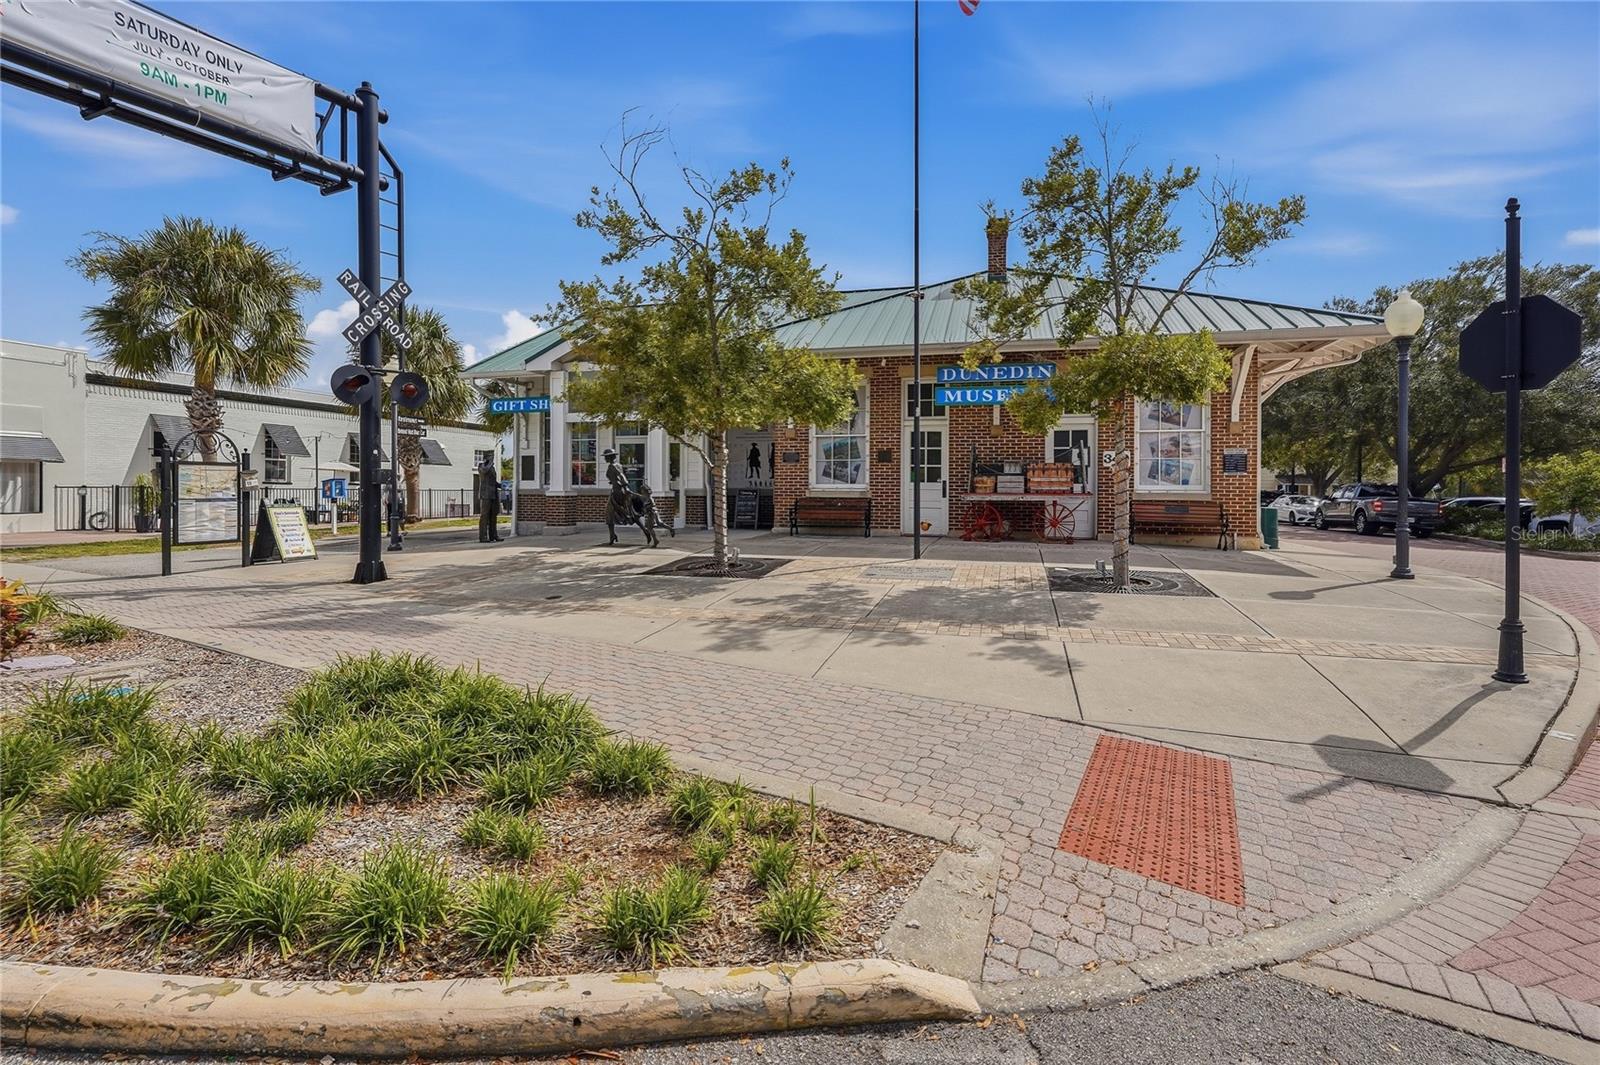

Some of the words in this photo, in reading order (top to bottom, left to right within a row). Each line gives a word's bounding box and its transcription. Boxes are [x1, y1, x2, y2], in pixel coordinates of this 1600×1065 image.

[114, 10, 200, 58] SATURDAY
[205, 50, 243, 74] ONLY
[133, 41, 164, 59] JULY
[175, 57, 230, 86] OCTOBER
[140, 61, 178, 88] 9AM
[195, 83, 228, 105] 1PM
[347, 282, 408, 342] CROSSING
[943, 365, 1053, 381] DUNEDIN
[944, 387, 1050, 402] MUSE
[493, 400, 527, 411] GIFT
[530, 399, 548, 410] SH
